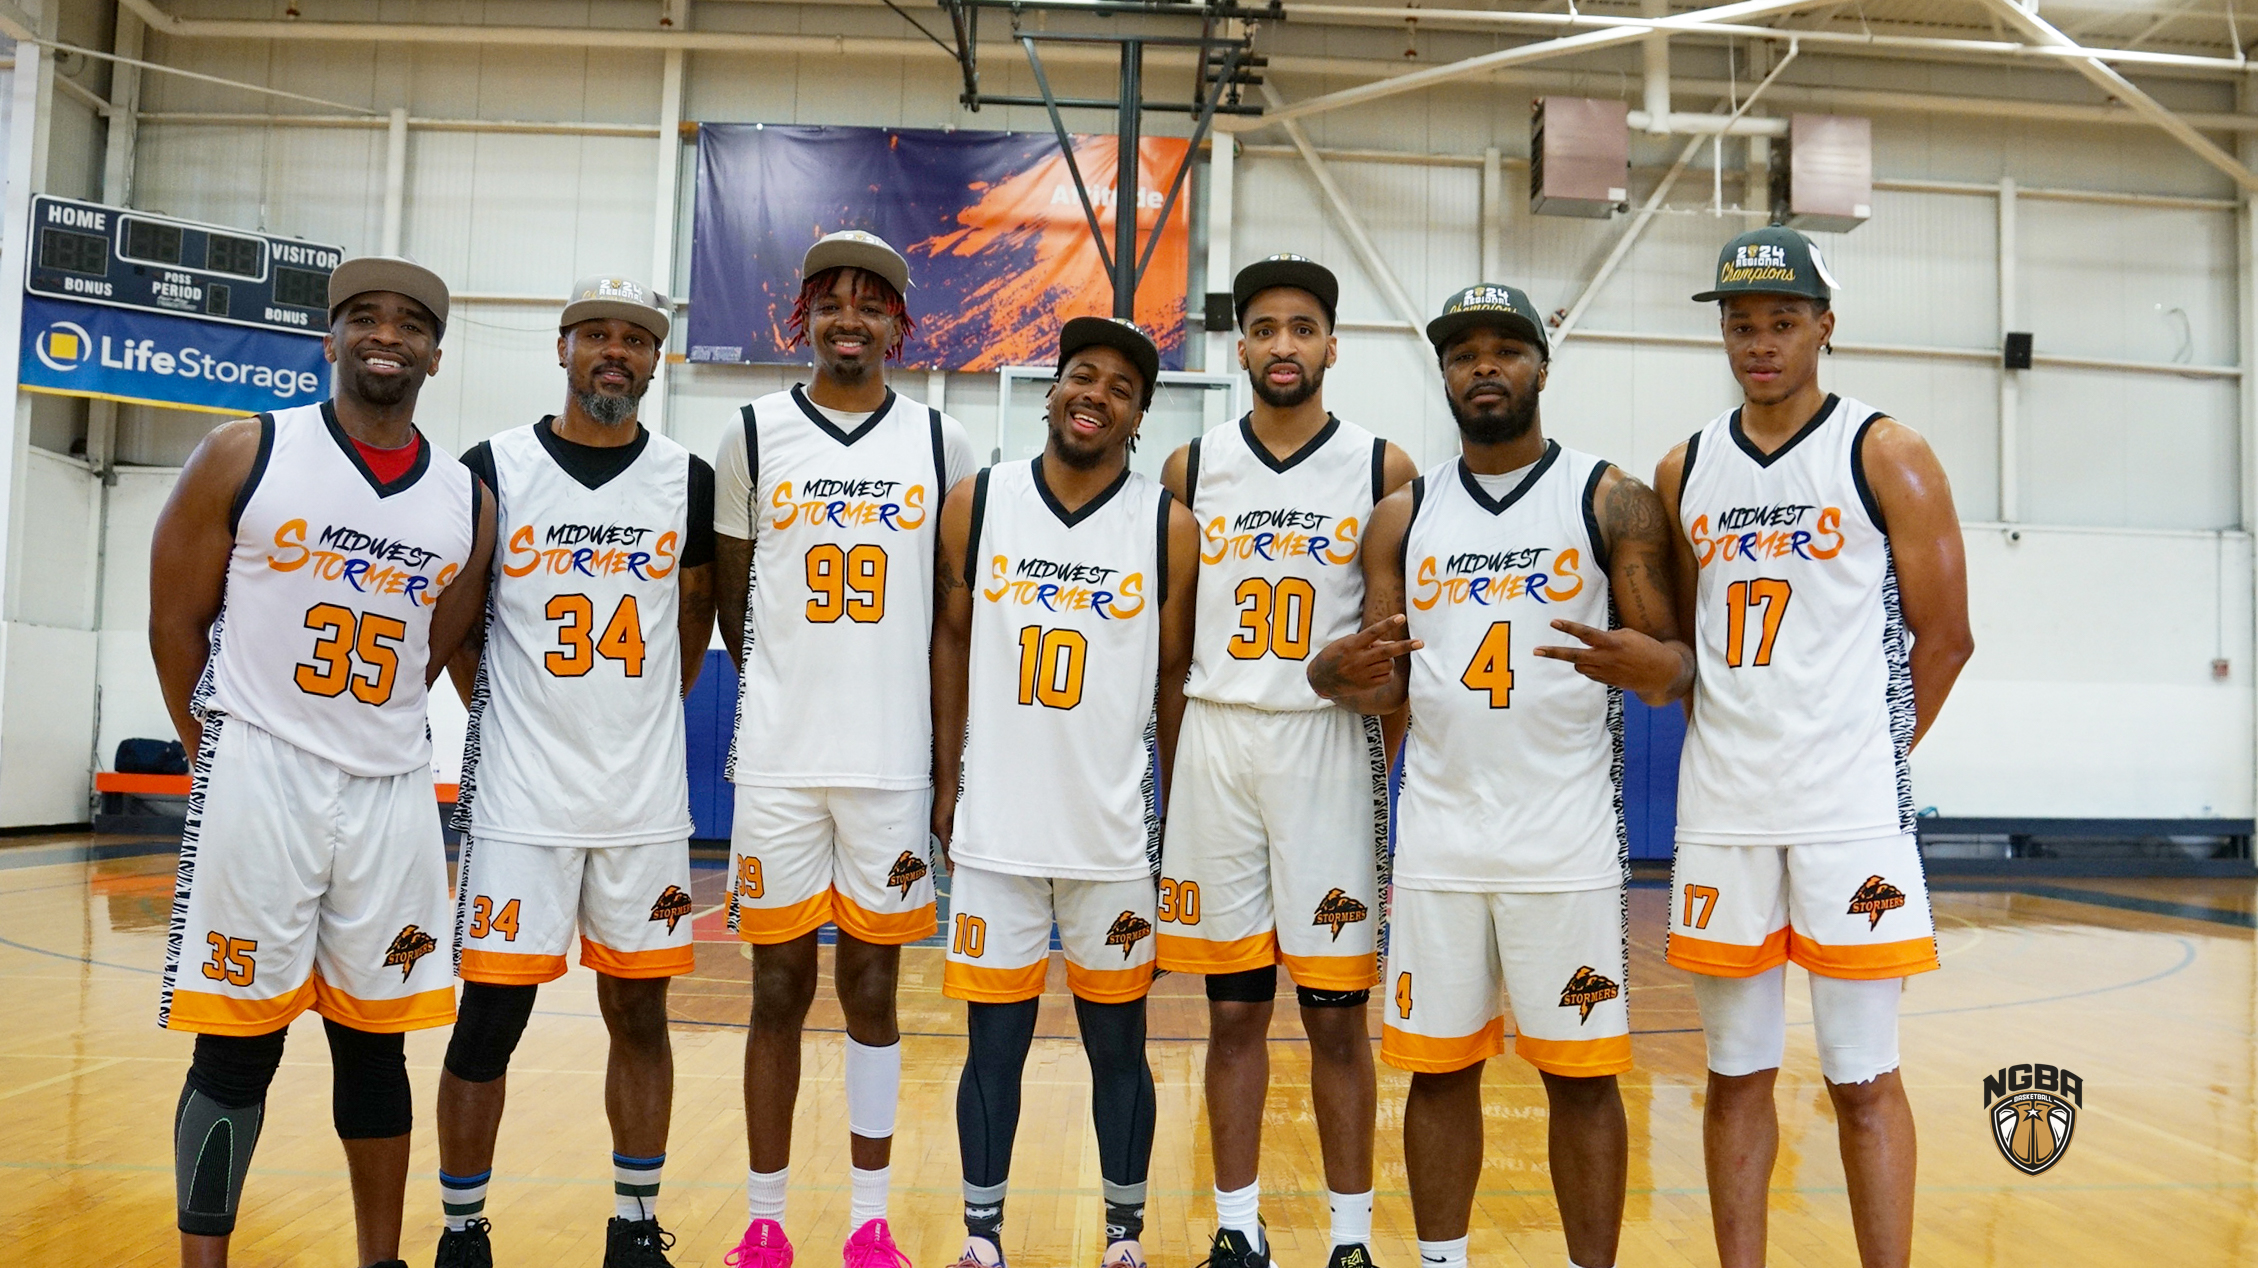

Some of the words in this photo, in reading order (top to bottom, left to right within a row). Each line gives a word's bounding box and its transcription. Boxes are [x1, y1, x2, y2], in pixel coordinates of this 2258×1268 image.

[48, 204, 106, 231] HOME
[164, 271, 192, 285] POSS
[271, 242, 339, 269] VISITOR
[1721, 260, 1796, 284] Champions
[1735, 257, 1786, 268] REGIONAL
[64, 276, 113, 297] BONUS
[151, 281, 202, 301] PERIOD
[599, 288, 644, 304] REGIONAL
[264, 307, 309, 326] BONUS
[772, 480, 926, 531] STORMERS
[802, 477, 902, 499] MIDWEST
[546, 521, 655, 547] MIDWEST
[1233, 507, 1333, 532] MIDWEST
[1718, 502, 1817, 532] MIDWEST
[318, 524, 442, 571] MIDWEST
[503, 525, 678, 581] STORMERS
[1201, 516, 1359, 566] STORMERS
[1446, 546, 1554, 576] MIDWEST
[805, 543, 888, 624] 99
[983, 554, 1146, 620] STORMERS
[1016, 558, 1121, 586] MIDWEST
[1412, 548, 1584, 611] STORMERS
[544, 592, 646, 678] 34
[1227, 576, 1316, 661] 30
[1726, 577, 1793, 669] 17
[293, 601, 406, 707] 35
[1018, 624, 1088, 711] 10
[1460, 620, 1514, 709] 4
[469, 894, 522, 942] 34
[1158, 876, 1201, 926] 30
[1316, 909, 1366, 924] STORMERS
[1683, 883, 1720, 930] 17
[1852, 896, 1905, 913] STORMERS
[201, 930, 258, 987] 35
[953, 912, 987, 959] 10
[1395, 971, 1413, 1020] 4
[1563, 986, 1617, 1005] STORMERS
